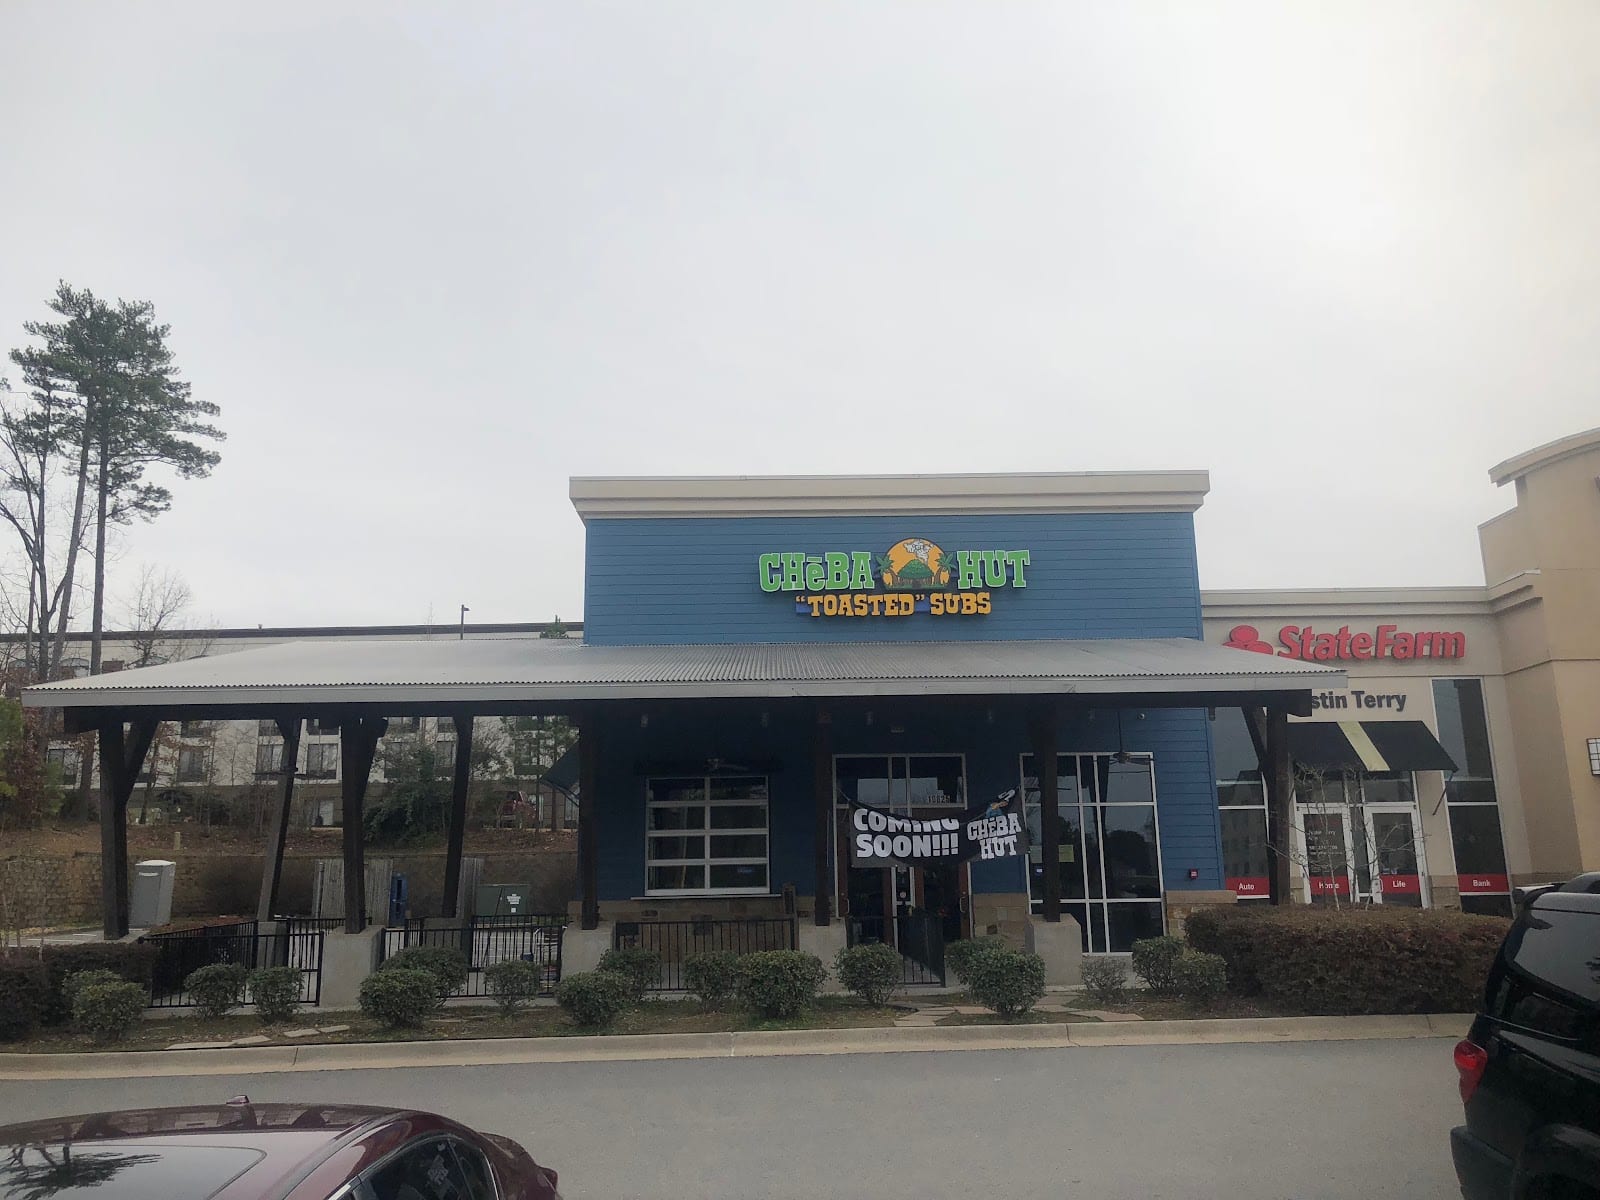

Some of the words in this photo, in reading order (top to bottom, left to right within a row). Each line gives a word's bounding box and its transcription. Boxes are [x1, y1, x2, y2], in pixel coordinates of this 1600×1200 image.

[957, 550, 1030, 589] HUT
[930, 592, 991, 615] SUBS
[1351, 691, 1407, 712] Terry
[856, 833, 959, 858] SOON!!!
[978, 832, 1017, 860] HUT
[1238, 882, 1255, 891] Auto
[1392, 879, 1407, 888] Life
[1472, 879, 1491, 888] Bank
